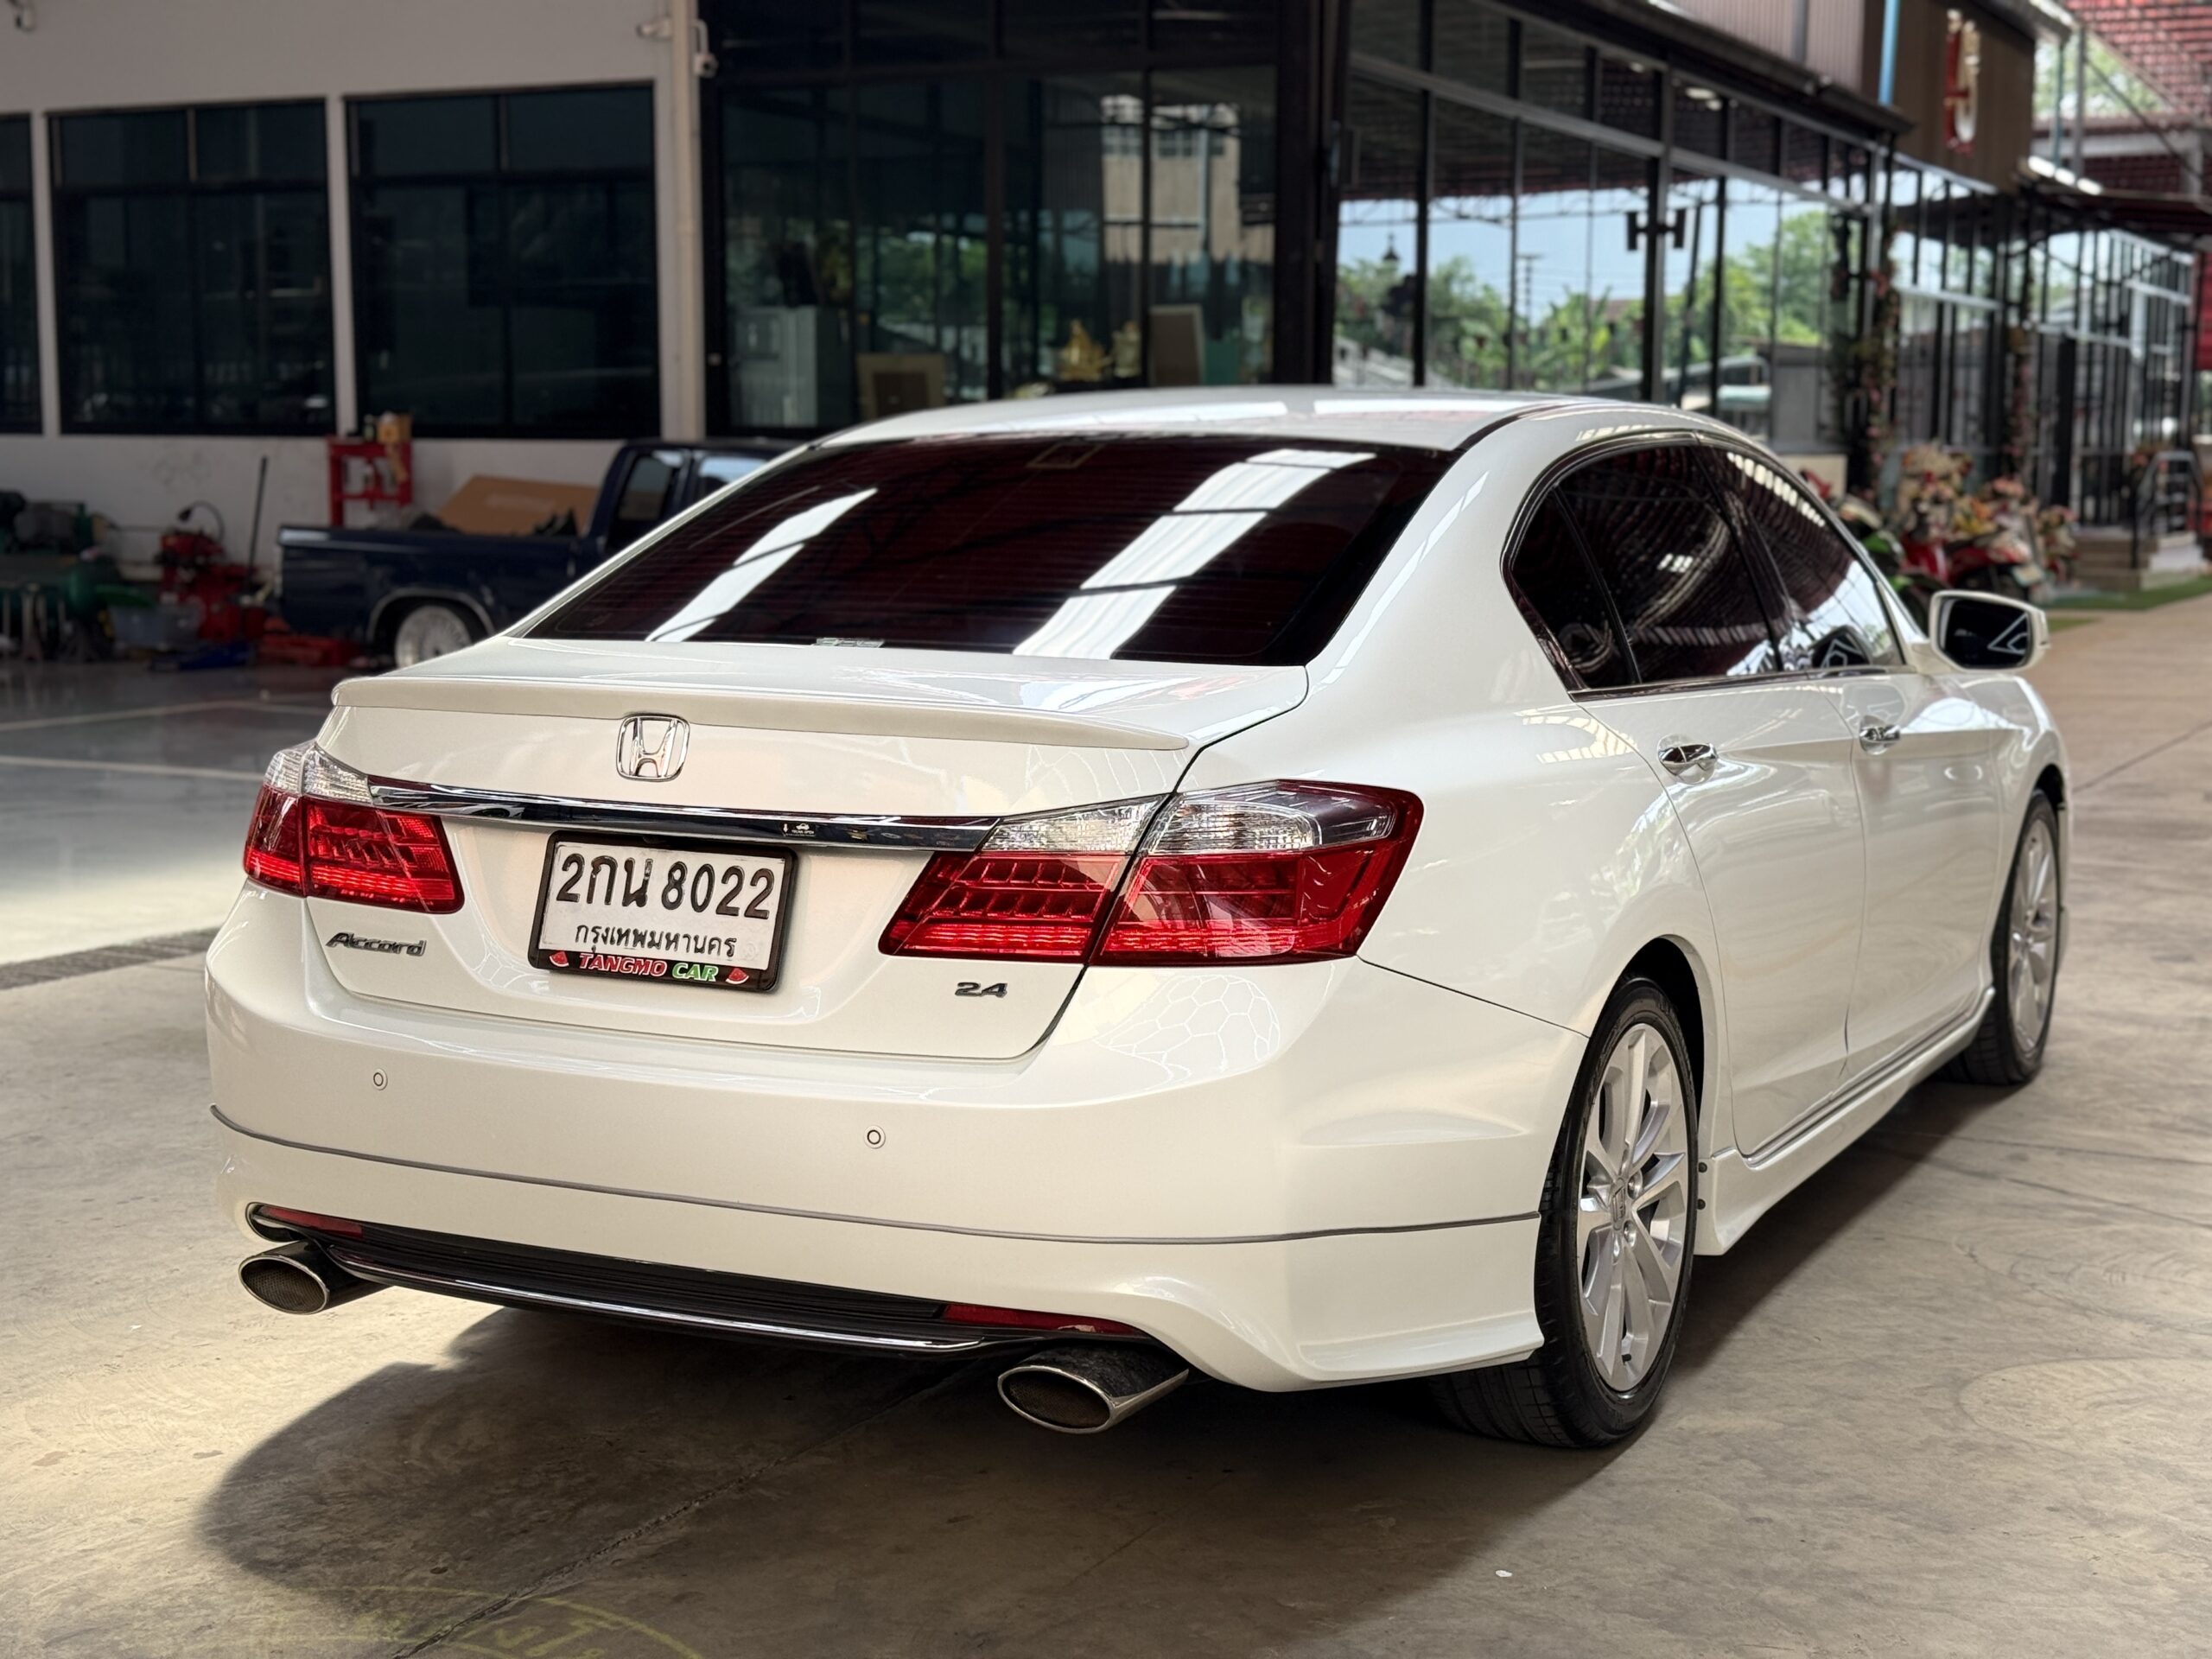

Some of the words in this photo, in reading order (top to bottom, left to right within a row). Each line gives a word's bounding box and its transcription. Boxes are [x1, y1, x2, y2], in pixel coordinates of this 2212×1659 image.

[556, 853, 653, 907] 2กน
[661, 861, 775, 919] 8022
[326, 931, 427, 957] Accord
[575, 924, 737, 957] กรุงเทพมหานคร
[579, 952, 668, 977] TANGMO
[671, 962, 719, 982] CAR
